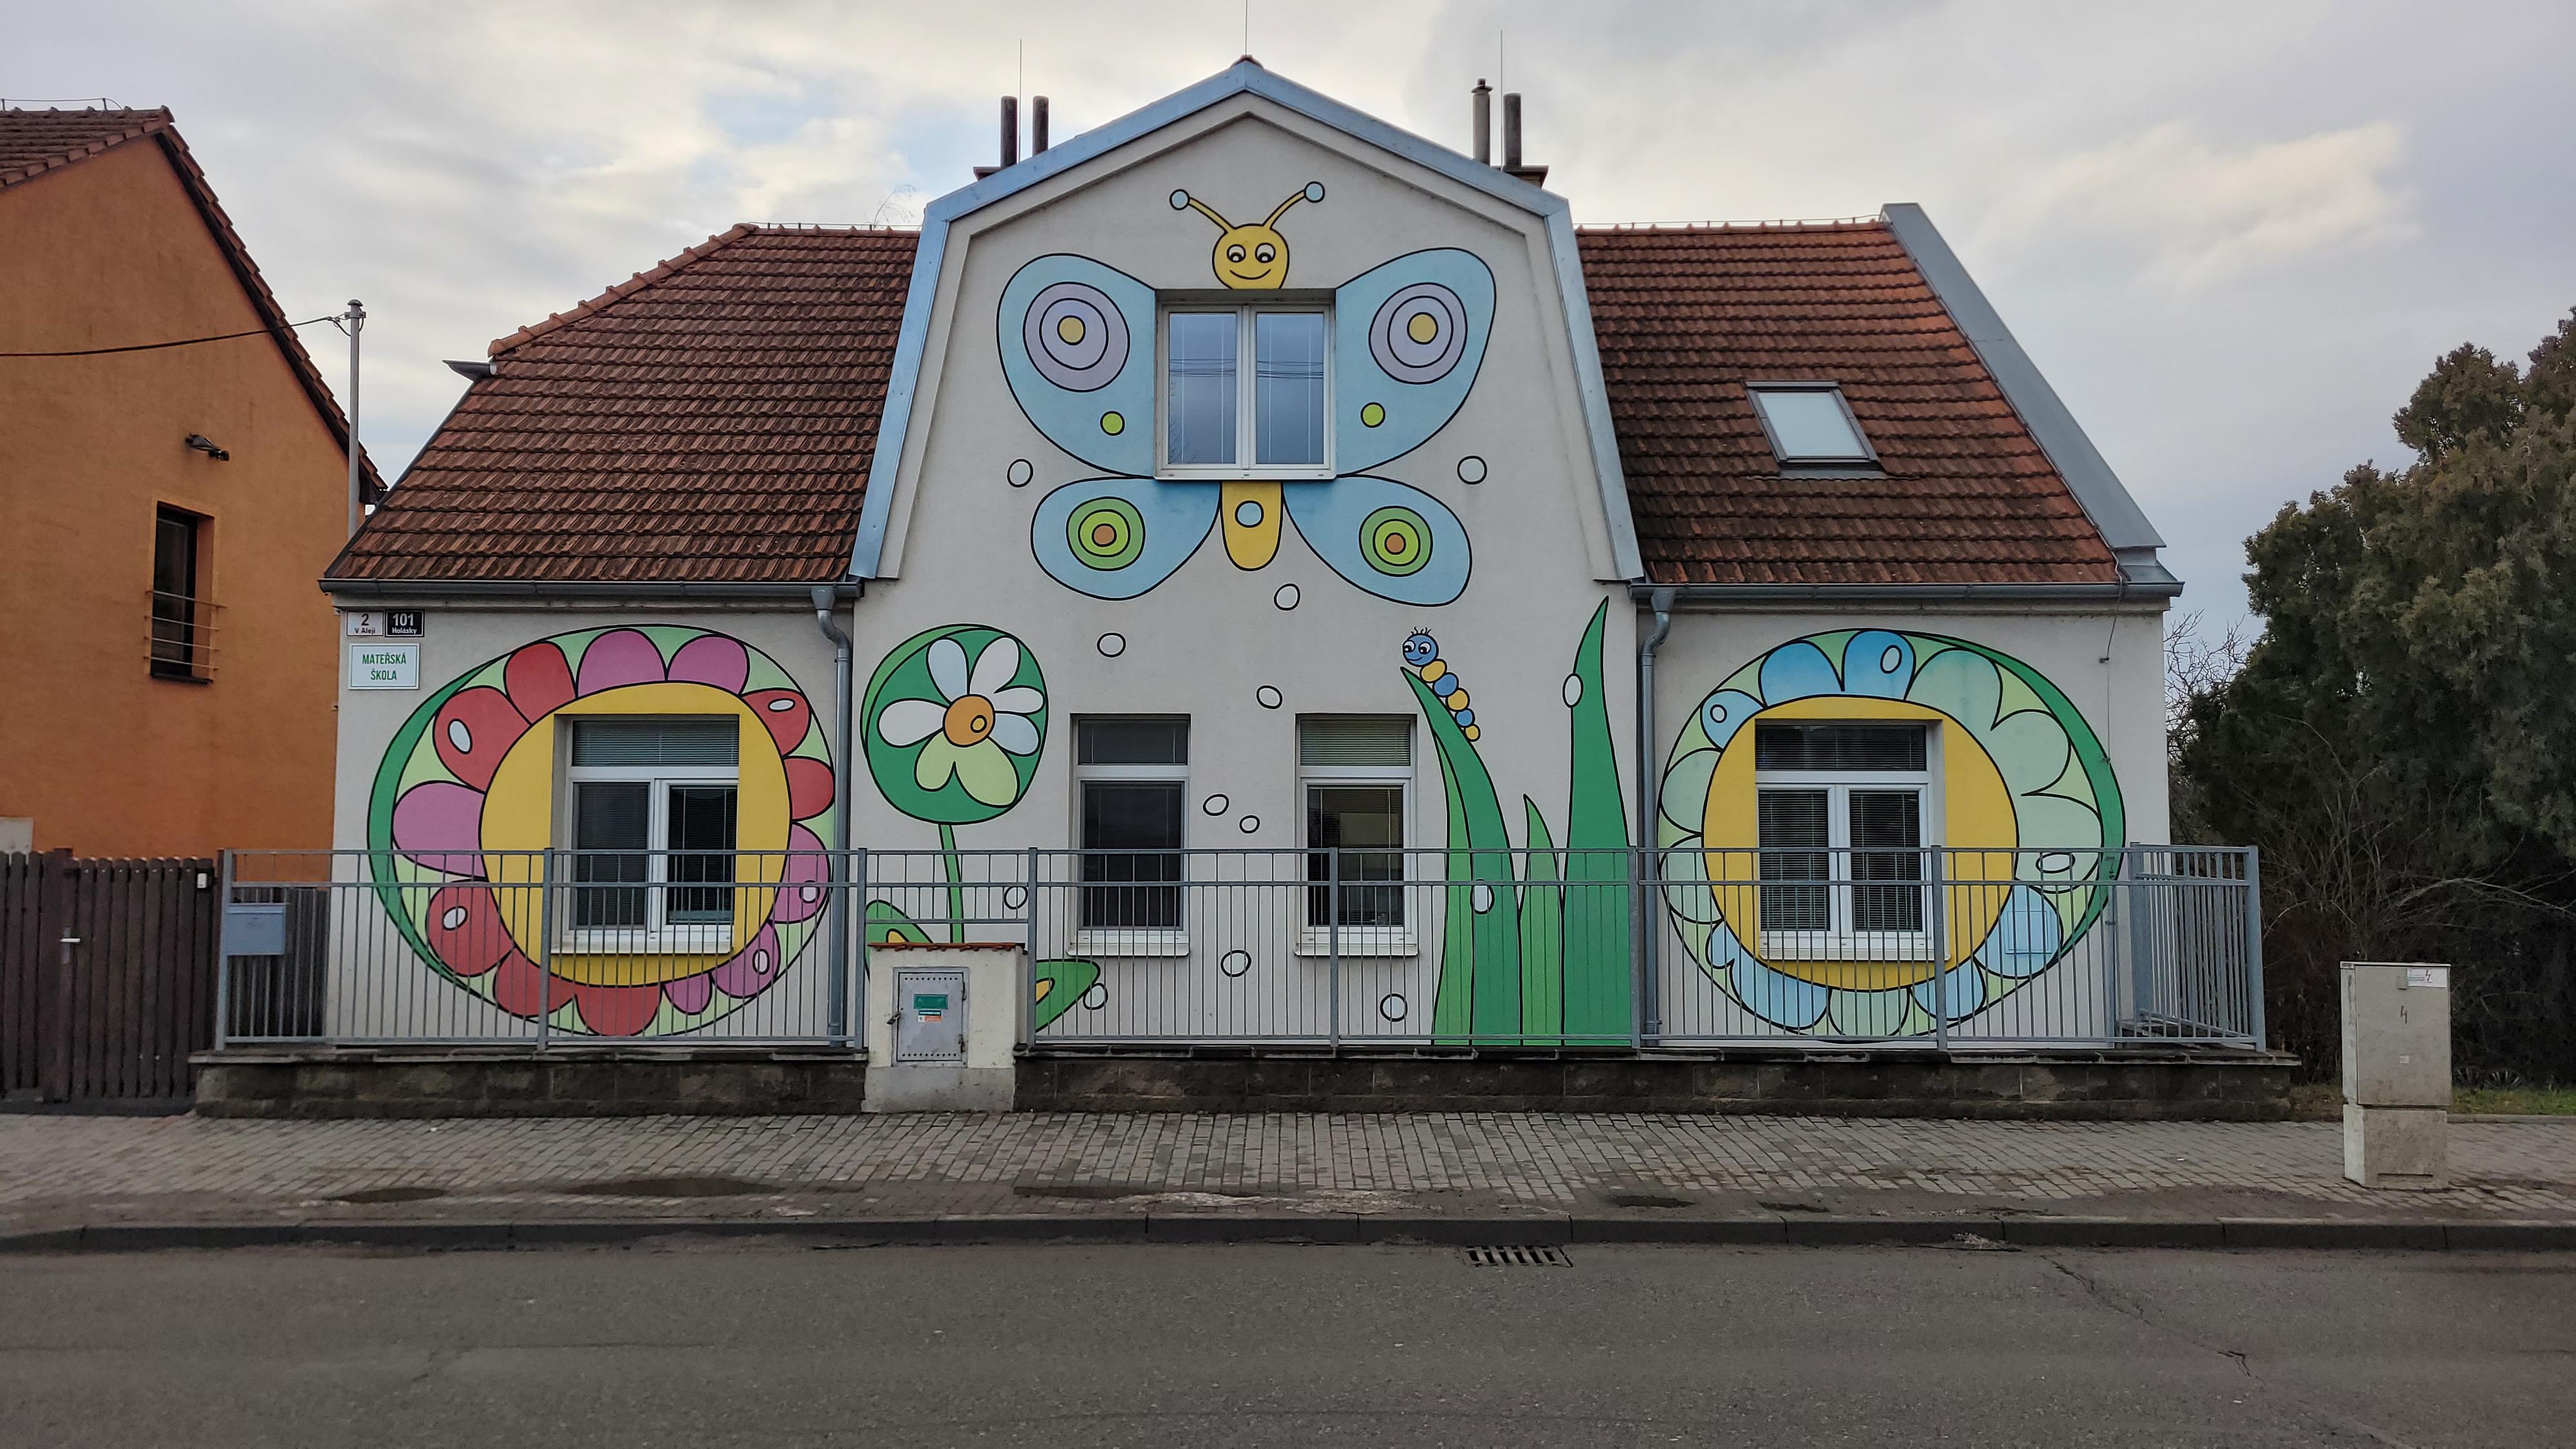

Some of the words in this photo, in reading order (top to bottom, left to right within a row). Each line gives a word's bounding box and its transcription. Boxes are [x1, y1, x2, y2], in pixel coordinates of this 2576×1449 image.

[361, 614, 369, 626] 2
[393, 613, 413, 626] 101
[362, 652, 406, 665] MATEŘSKÁ
[370, 668, 397, 680] ŠKOLA
